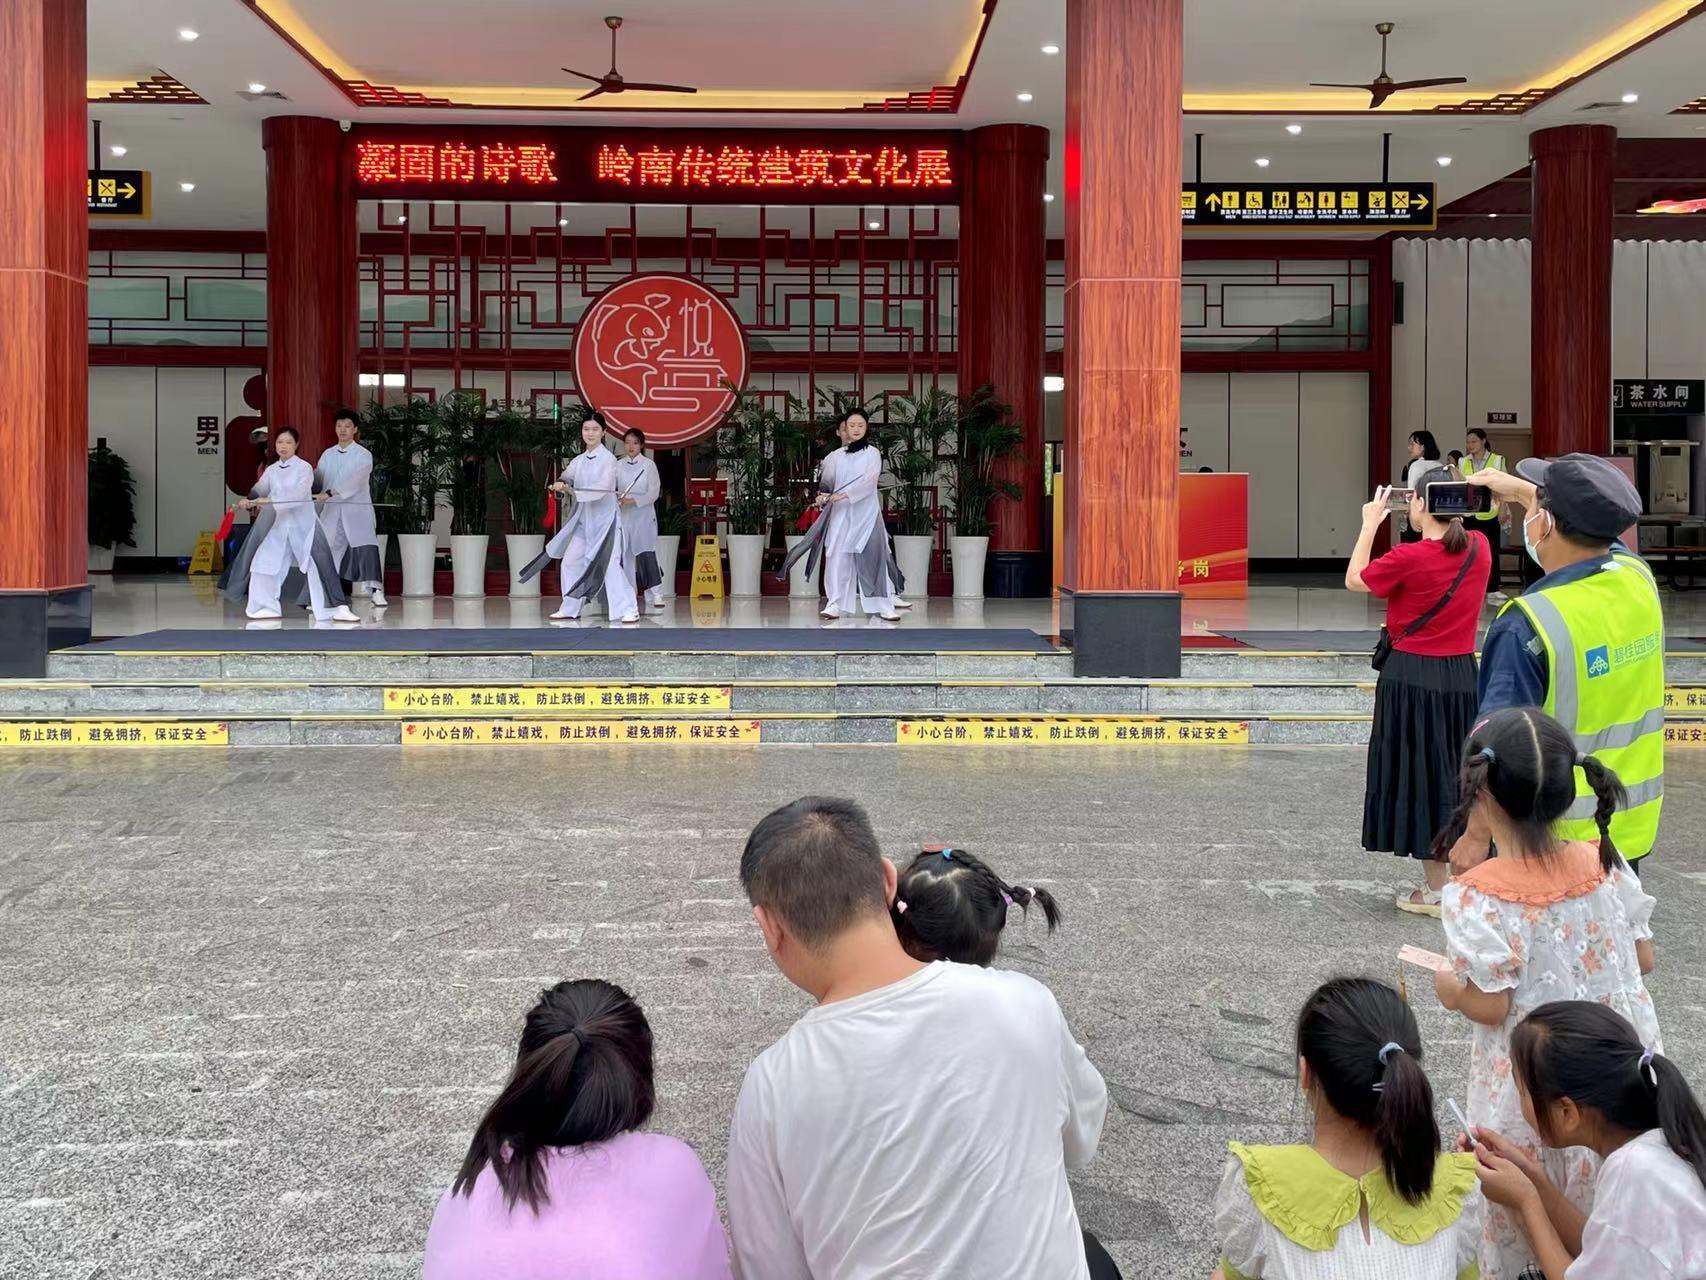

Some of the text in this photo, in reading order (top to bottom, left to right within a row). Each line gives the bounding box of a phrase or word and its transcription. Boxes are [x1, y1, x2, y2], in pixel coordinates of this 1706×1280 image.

[598, 145, 953, 187] 岭南传统建筑文化展
[1630, 384, 1689, 400] 茶水间
[196, 416, 220, 446] 男
[0, 728, 207, 742] ，防止跌倒，避免拥挤，保证安全
